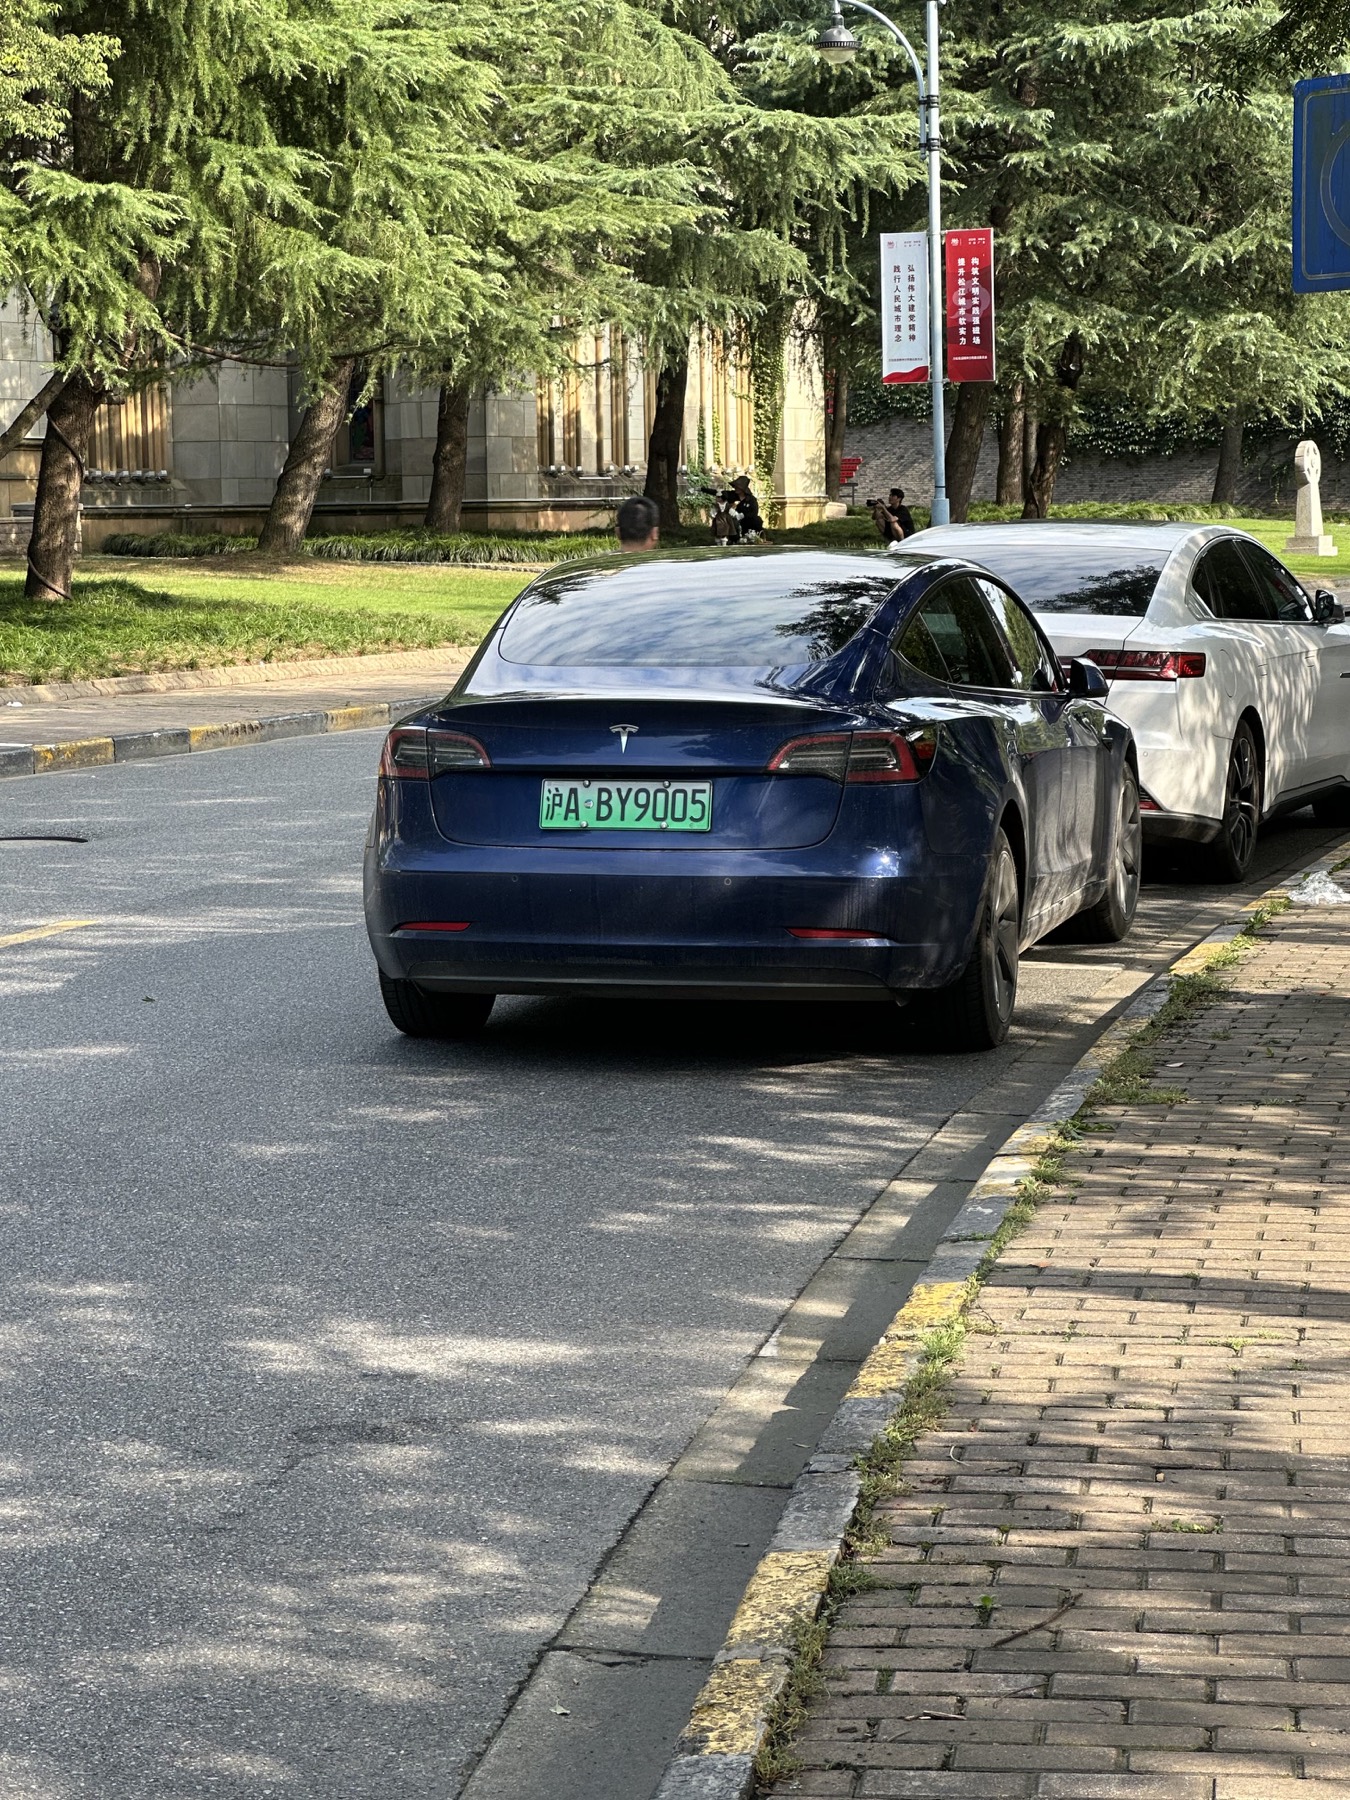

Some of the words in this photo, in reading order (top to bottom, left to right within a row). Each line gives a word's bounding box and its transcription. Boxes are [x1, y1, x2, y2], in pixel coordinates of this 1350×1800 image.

[893, 265, 902, 343] 践行人民城市理念
[907, 264, 916, 342] 弘扬伟大建党精神
[957, 257, 967, 346] 提升松江城市软实力
[971, 257, 981, 345] 构筑文明实践强磁场
